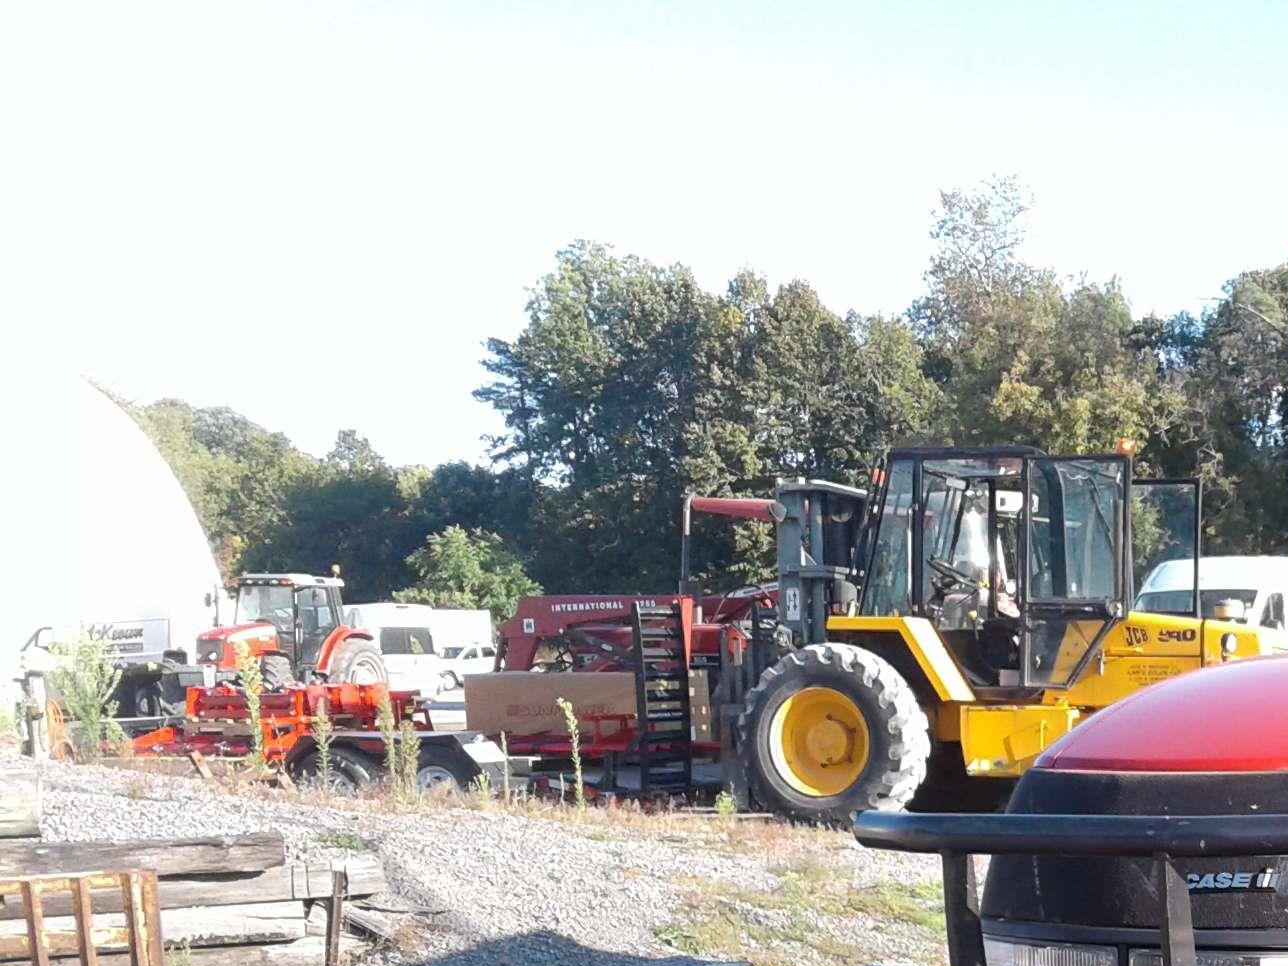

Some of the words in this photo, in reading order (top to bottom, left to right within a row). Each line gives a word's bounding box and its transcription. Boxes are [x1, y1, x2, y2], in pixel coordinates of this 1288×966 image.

[551, 604, 624, 612] INTERNATIONAL
[1125, 626, 1149, 646] JCB
[1186, 872, 1252, 889] CASE
